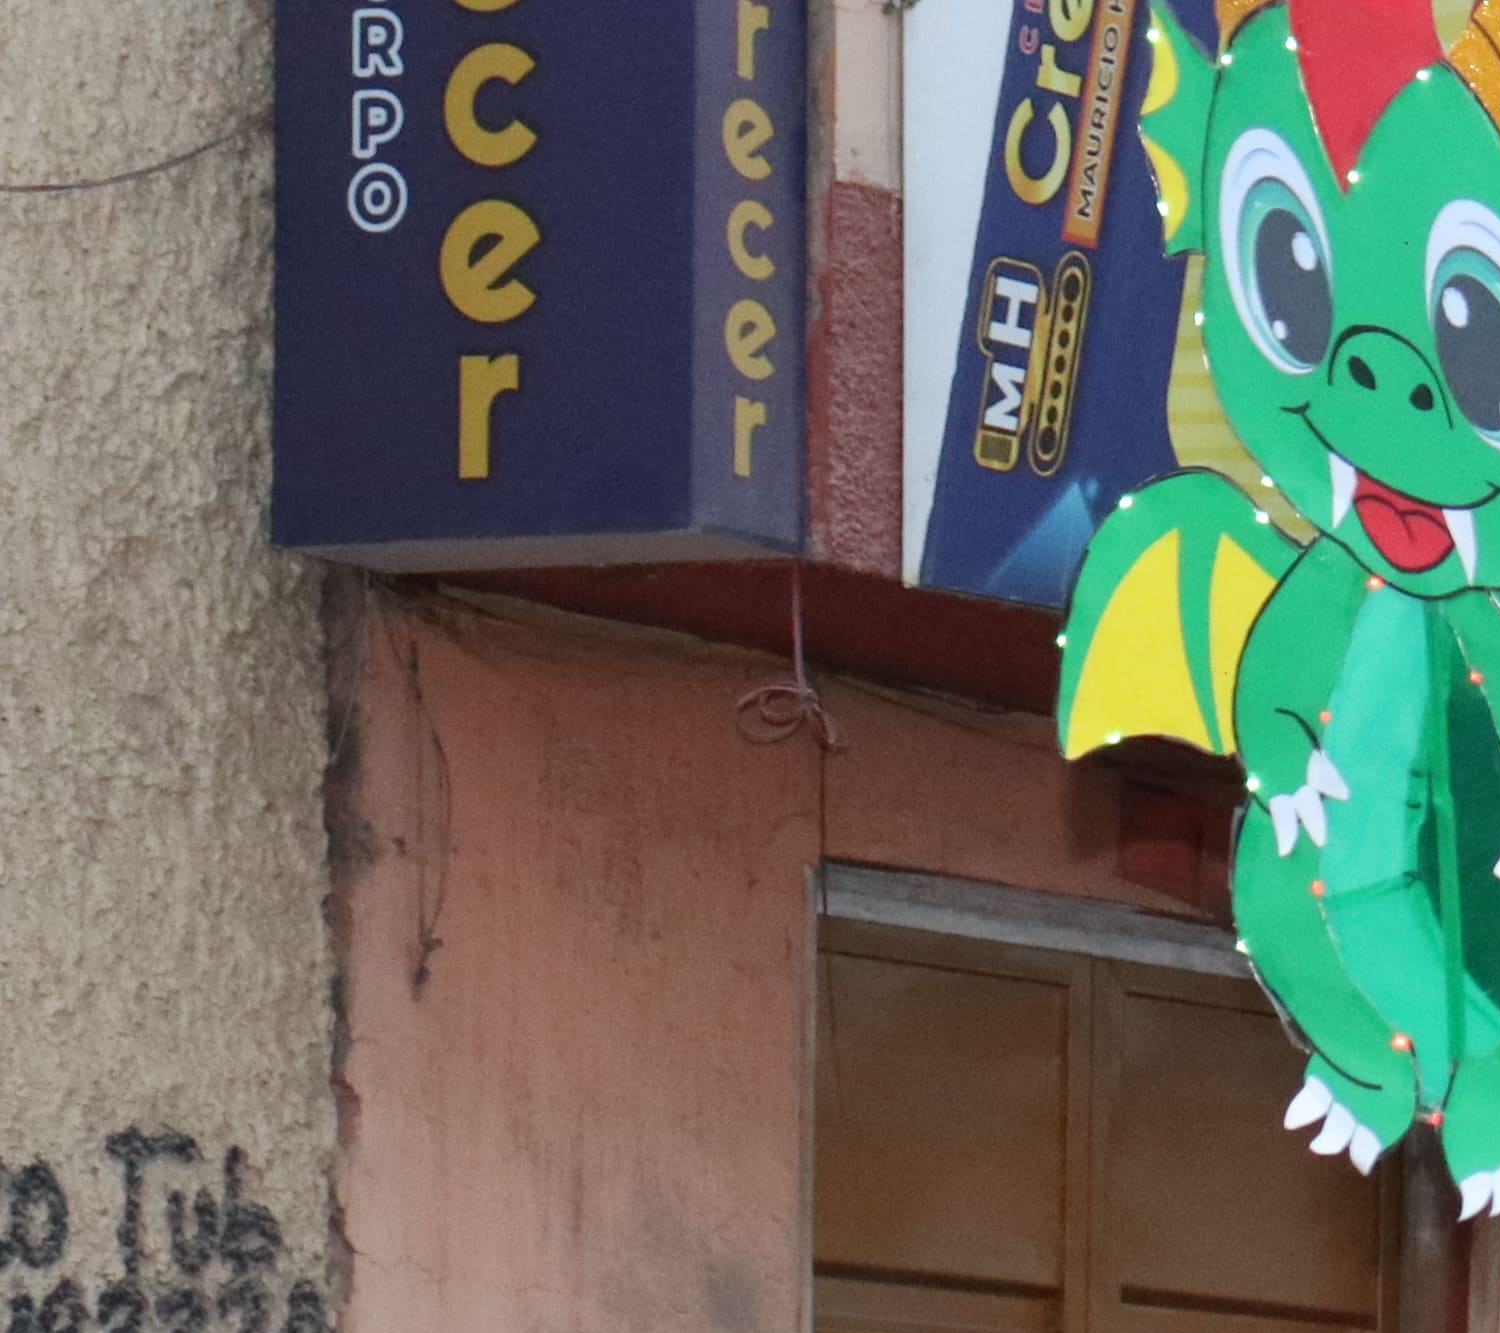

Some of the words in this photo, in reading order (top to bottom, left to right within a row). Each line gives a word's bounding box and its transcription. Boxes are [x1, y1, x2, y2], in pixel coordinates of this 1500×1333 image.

[348, 0, 408, 233] RPO
[1004, 0, 1097, 206] Cre
[438, 0, 543, 480] cer
